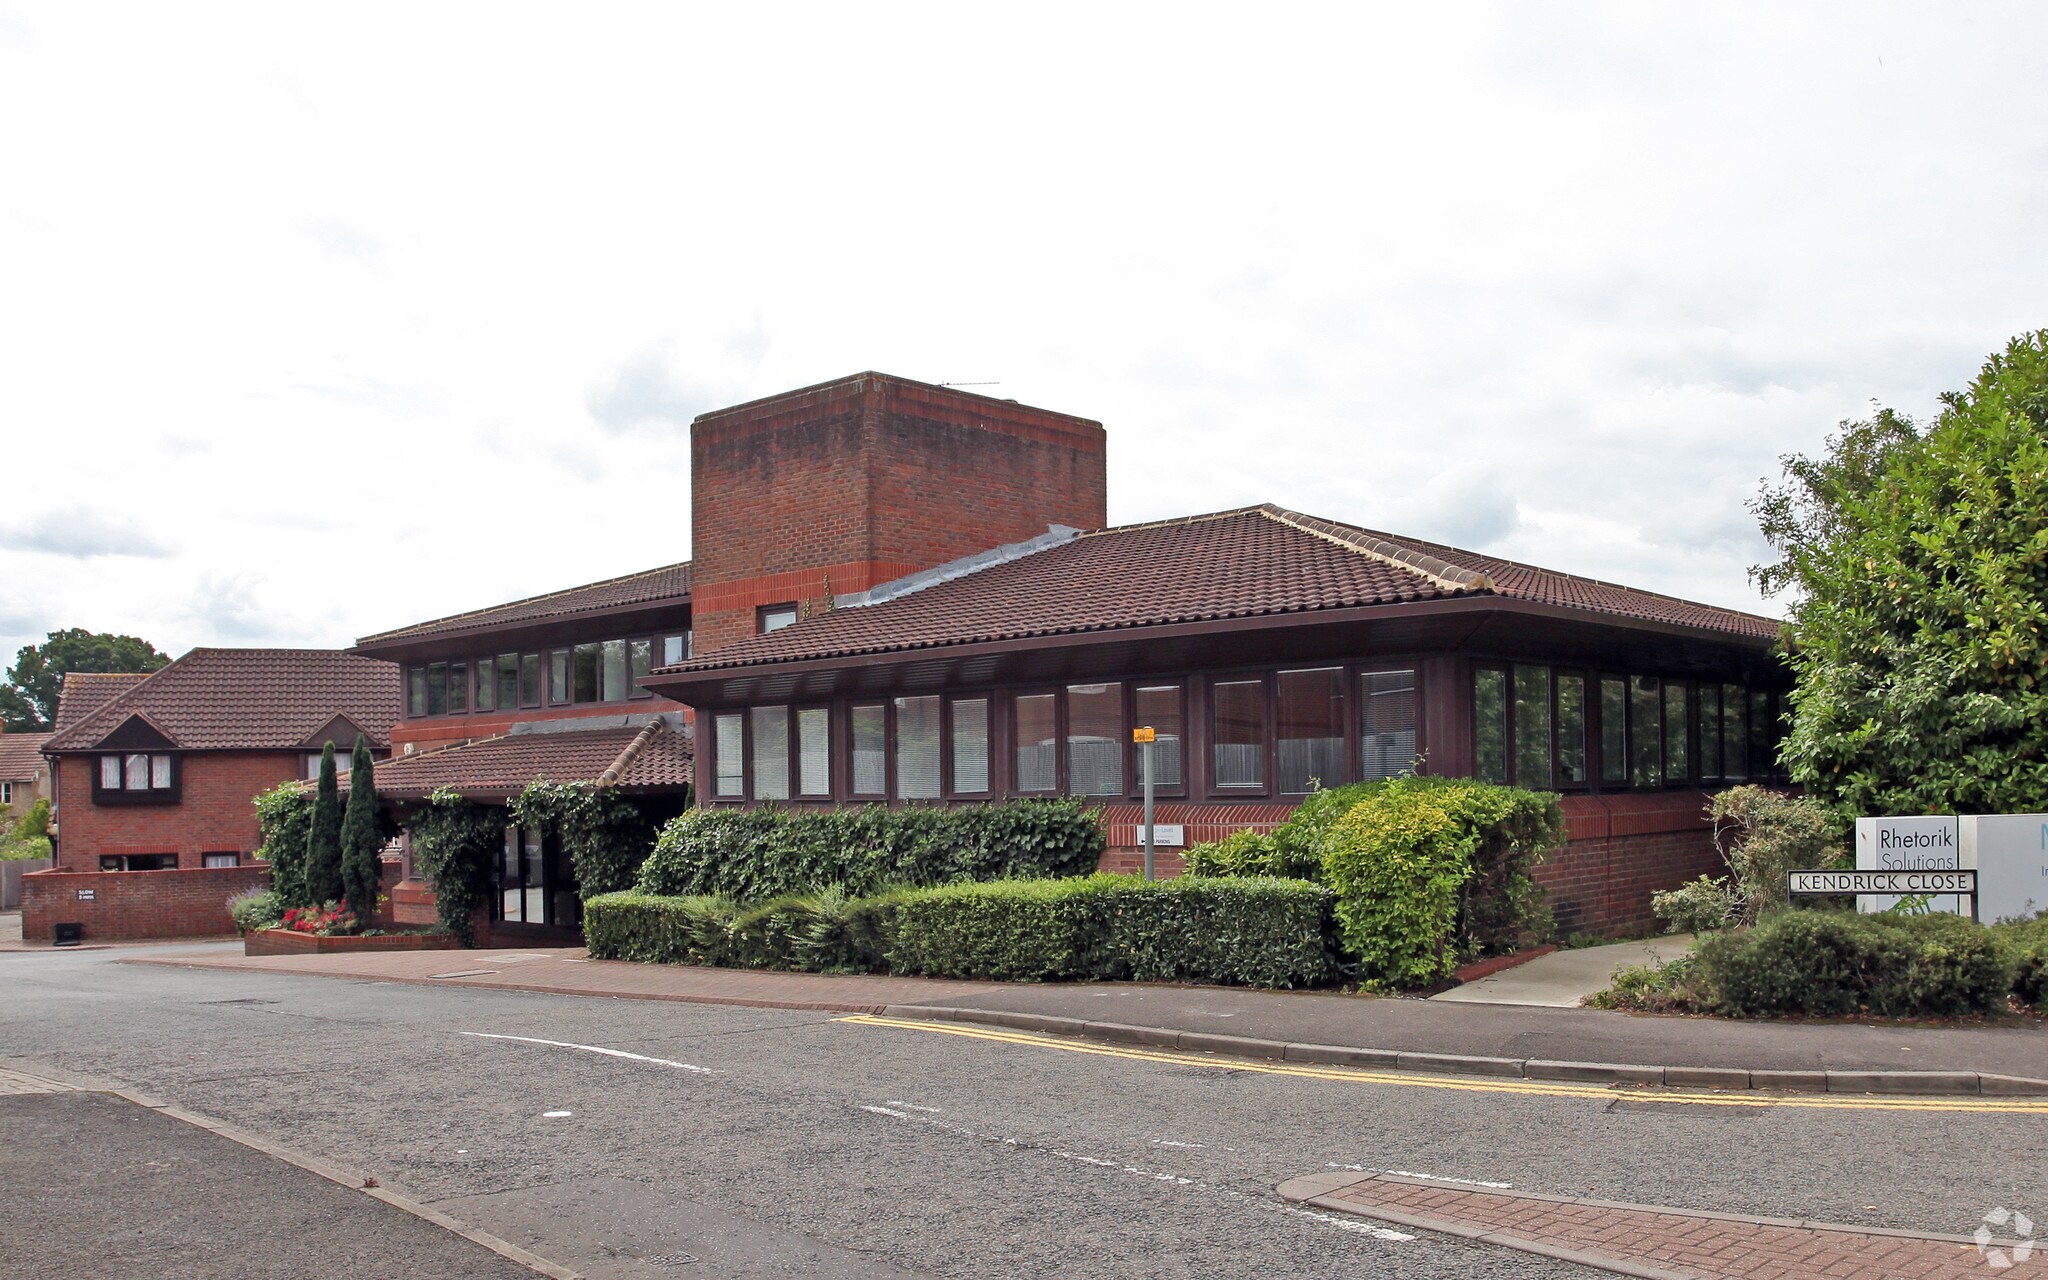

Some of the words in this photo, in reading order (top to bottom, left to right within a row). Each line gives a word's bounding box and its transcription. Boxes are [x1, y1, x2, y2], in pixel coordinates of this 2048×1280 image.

[1880, 825, 1953, 849] Rhetorik
[1881, 851, 1954, 871] Solutions
[1799, 874, 1900, 890] KENDRICK
[1907, 874, 1967, 890] CLOSE
